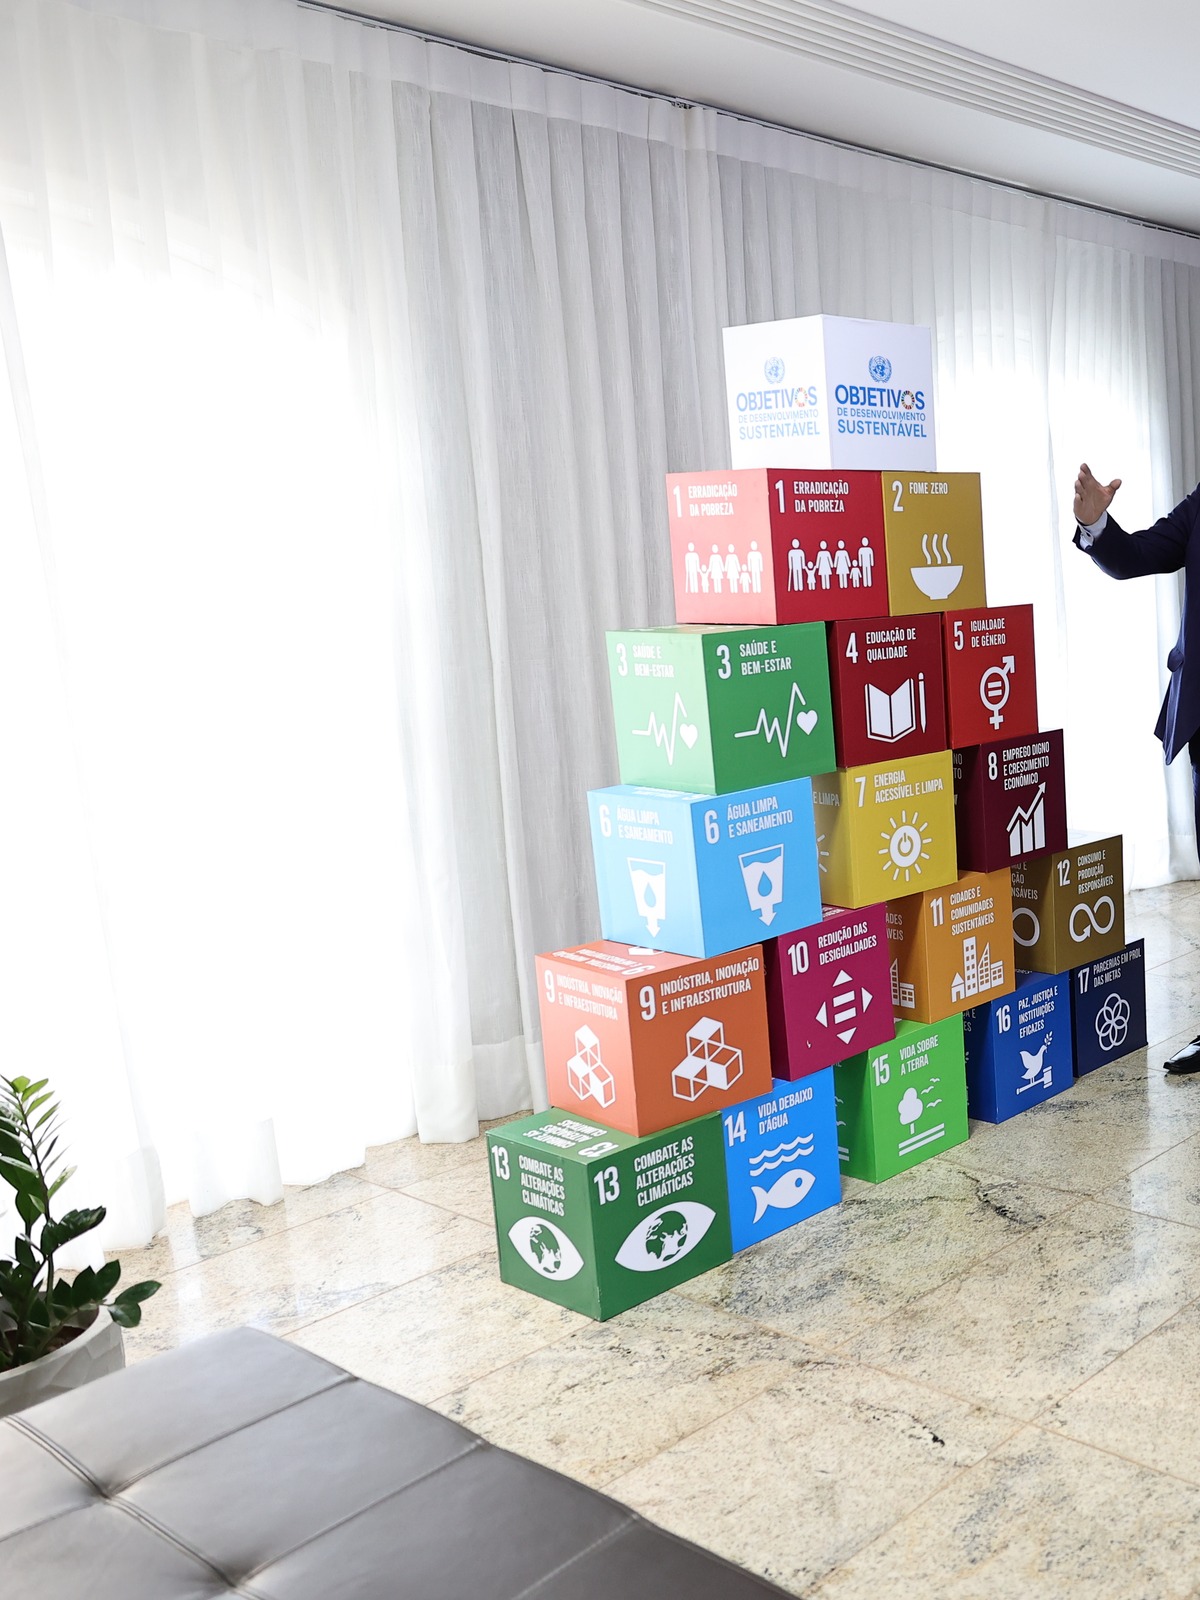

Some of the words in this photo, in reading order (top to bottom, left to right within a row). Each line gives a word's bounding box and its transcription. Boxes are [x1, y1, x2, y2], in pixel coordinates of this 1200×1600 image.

[736, 386, 818, 412] OBJETIVOS
[835, 384, 925, 410] OBJETIVOS
[738, 414, 748, 423] DE
[750, 409, 819, 423] DESENVOLVIMENTO
[837, 407, 849, 417] DE
[850, 408, 926, 422] DESENVOLVIMENTO
[739, 420, 820, 440] SUSTENTÁVEL
[837, 419, 927, 438] SUSTENTÁVEL
[673, 484, 682, 518] 1
[688, 481, 738, 501] ERRADICAÇÃO
[775, 480, 785, 513] 1
[793, 479, 849, 498] ERRADICAÇÃO
[892, 480, 904, 512] 2
[909, 482, 929, 494] FOME
[930, 482, 948, 495] ZERO
[690, 502, 700, 516] DA
[701, 500, 734, 516] POBREZA
[795, 500, 806, 513] DA
[808, 499, 845, 513] POBREZA
[866, 627, 905, 645] EDUCAÇÃO
[906, 628, 916, 641] DE
[953, 621, 964, 650] 5
[970, 618, 1006, 632] IGUALDADE
[632, 640, 656, 659] SAÚDE
[656, 646, 662, 659] E
[739, 640, 768, 657] SAÚDE
[770, 640, 777, 654] E
[845, 632, 859, 664] 4
[971, 636, 980, 648] DE
[981, 632, 1006, 647] GÊNERO
[616, 642, 628, 677] 3
[716, 644, 732, 680] 3
[741, 656, 792, 676] BEM-ESTAR
[866, 646, 908, 663] QUALIDADE
[634, 662, 674, 678] BEM-ESTAR
[1003, 745, 1031, 762] EMPREGO
[1032, 741, 1050, 757] DIGNO
[874, 769, 906, 788] ENERGIA
[987, 752, 998, 781] 8
[1003, 765, 1008, 776] E
[1009, 755, 1050, 775] CRESCIMENTO
[855, 776, 867, 808] 7
[875, 782, 914, 804] ACESSÍVEL
[916, 783, 921, 795] E
[921, 778, 944, 794] LIMPA
[1004, 771, 1039, 791] ECONÔMICO
[727, 803, 751, 821] ÁGUA
[752, 796, 779, 814] LIMPA
[819, 792, 840, 806] LIMPA
[599, 804, 612, 838] 6
[616, 804, 636, 823] ÁGUA
[636, 810, 660, 825] LIMPA
[704, 809, 720, 845] 6
[728, 824, 736, 839] E
[736, 809, 793, 836] SANEAMENTO
[618, 825, 625, 838] E
[625, 826, 673, 845] SANEAMENTO
[1077, 851, 1102, 867] CONSUMO
[1102, 849, 1106, 860] E
[1057, 858, 1071, 887] 12
[1077, 864, 1104, 881] PRODUÇÃO
[1078, 874, 1113, 895] RESPONSÁVEIS
[950, 888, 975, 905] CIDADES
[976, 885, 981, 897] E
[1011, 886, 1038, 900] NSÁVEIS
[930, 896, 944, 927] 11
[951, 897, 994, 921] COMUNIDADES
[818, 926, 852, 948] REDUÇÃO
[853, 921, 868, 938] DAS
[951, 912, 995, 936] SUSTENTÁVEIS
[787, 940, 810, 976] 10
[819, 934, 877, 966] DESIGUALDADES
[1093, 956, 1121, 975] PARCERIAS
[1121, 953, 1129, 966] EM
[1129, 948, 1142, 962] PROL
[544, 969, 556, 1003] 9
[557, 974, 591, 995] INDÚSTRIA,
[592, 983, 623, 1004] INOVAÇÃO
[660, 970, 713, 997] INDÚSTRIA,
[715, 957, 759, 982] INOVAÇÃO
[1077, 967, 1090, 994] 17
[1094, 975, 1104, 988] DAS
[1104, 969, 1122, 984] METAS
[558, 992, 564, 1004] E
[564, 993, 618, 1021] INFRAESTRUTURA
[639, 985, 656, 1021] 9
[662, 1001, 669, 1015] E
[670, 978, 752, 1013] INFRAESTRUTURA
[1018, 997, 1030, 1011] PAZ,
[1030, 987, 1053, 1005] JUSTIÇA
[1054, 985, 1058, 996] E
[995, 1004, 1011, 1034] 16
[1018, 1000, 1055, 1024] INSTITUIÇÕES
[1019, 1019, 1045, 1039] EFICAZES
[899, 1046, 916, 1061] VIDA
[916, 1034, 939, 1054] SOBRE
[872, 1053, 890, 1087] 15
[900, 1064, 906, 1076] A
[906, 1054, 929, 1074] TERRA
[757, 1101, 779, 1119] VIDA
[779, 1087, 813, 1111] DEBAIXO
[724, 1110, 747, 1147] 14
[491, 1144, 511, 1181] 13
[633, 1141, 679, 1172] COMBATE
[681, 1135, 694, 1151] AS
[518, 1154, 553, 1177] COMBATE
[552, 1165, 564, 1183] AS
[636, 1153, 695, 1191] ALTERAÇÕES
[520, 1172, 565, 1200] ALTERAÇÕES
[593, 1165, 621, 1206] 13
[637, 1171, 694, 1208] CLIMÁTICAS
[522, 1188, 565, 1217] CLIMÁTICAS
